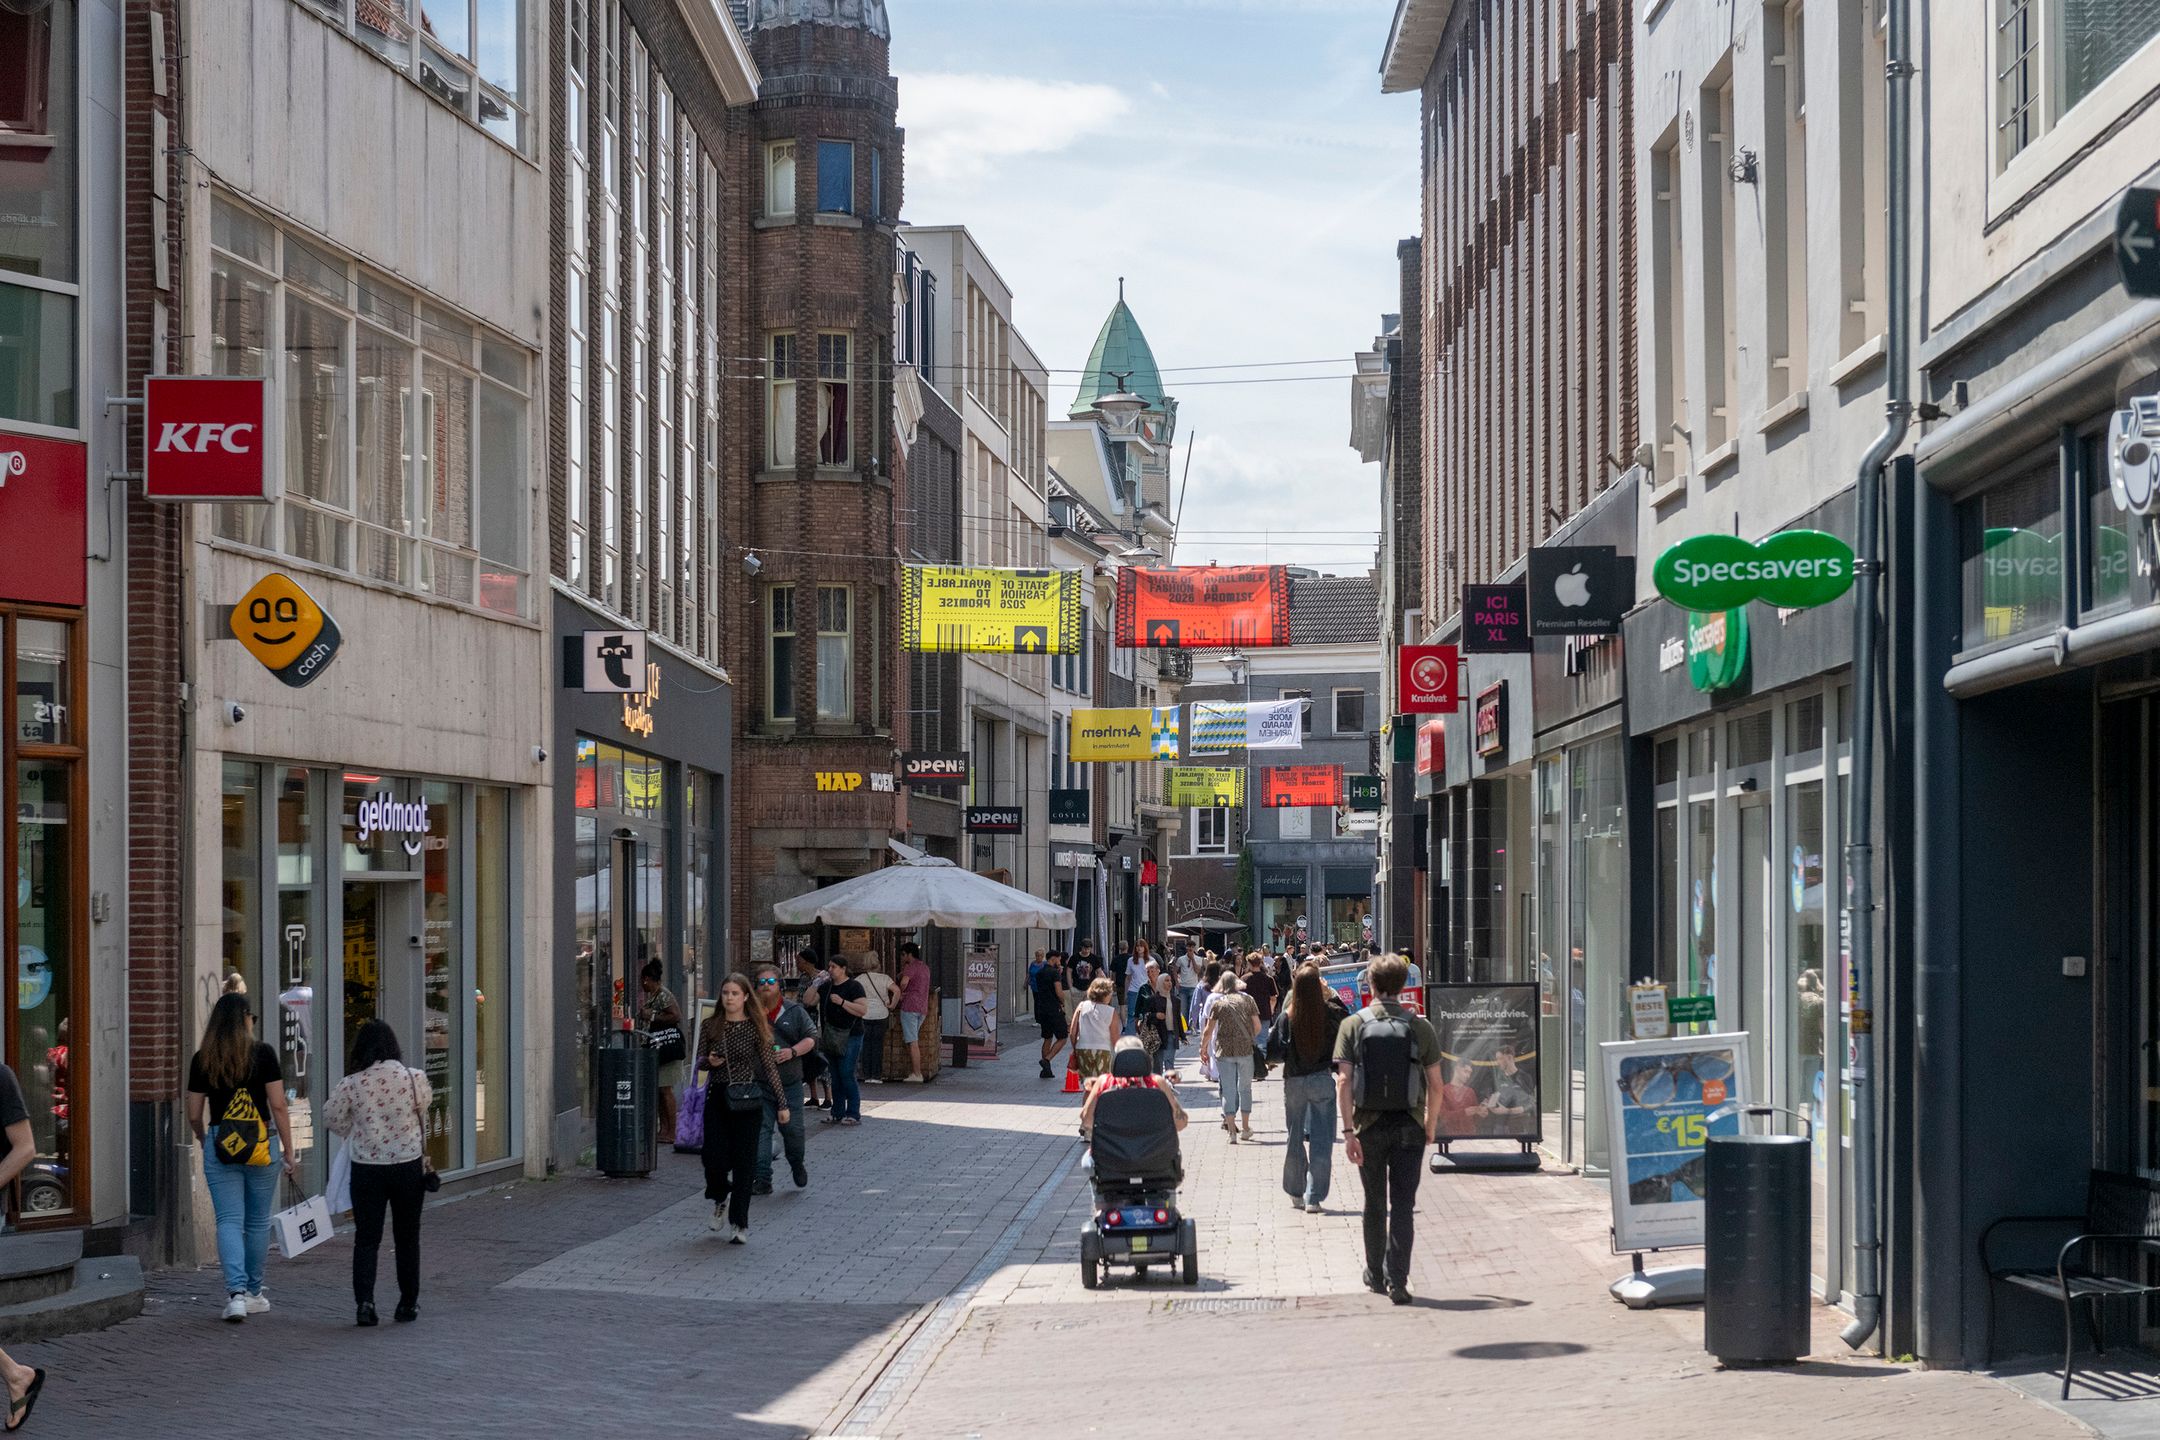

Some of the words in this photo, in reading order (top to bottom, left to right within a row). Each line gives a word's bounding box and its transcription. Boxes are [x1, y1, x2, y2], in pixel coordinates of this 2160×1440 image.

[154, 422, 253, 454] KFC
[1203, 573, 1265, 584] AVAILABLE
[1673, 558, 1843, 588] Specsavers
[1149, 584, 1195, 593] FASHION
[1203, 584, 1218, 593] TO
[1168, 593, 1195, 603] 2026
[1203, 592, 1255, 602] PROMISE
[1486, 596, 1508, 609] ICI
[1475, 612, 1519, 625] PARIS
[1536, 619, 1575, 628] Premium
[1577, 618, 1611, 627] Reseller
[1193, 629, 1211, 641] NL
[1487, 628, 1508, 641] XL
[297, 643, 330, 676] cash
[1411, 694, 1448, 703] Kruidvat
[906, 759, 958, 773] OPEN
[815, 772, 863, 792] HAP
[1352, 786, 1378, 798] H&B
[358, 791, 429, 841] geldmaat
[970, 812, 1013, 825] OPEN
[968, 962, 995, 973] 40%
[1440, 1009, 1493, 1020] Persoonlijk
[1494, 1008, 1529, 1018] advies.
[1656, 1113, 1707, 1148] €15
